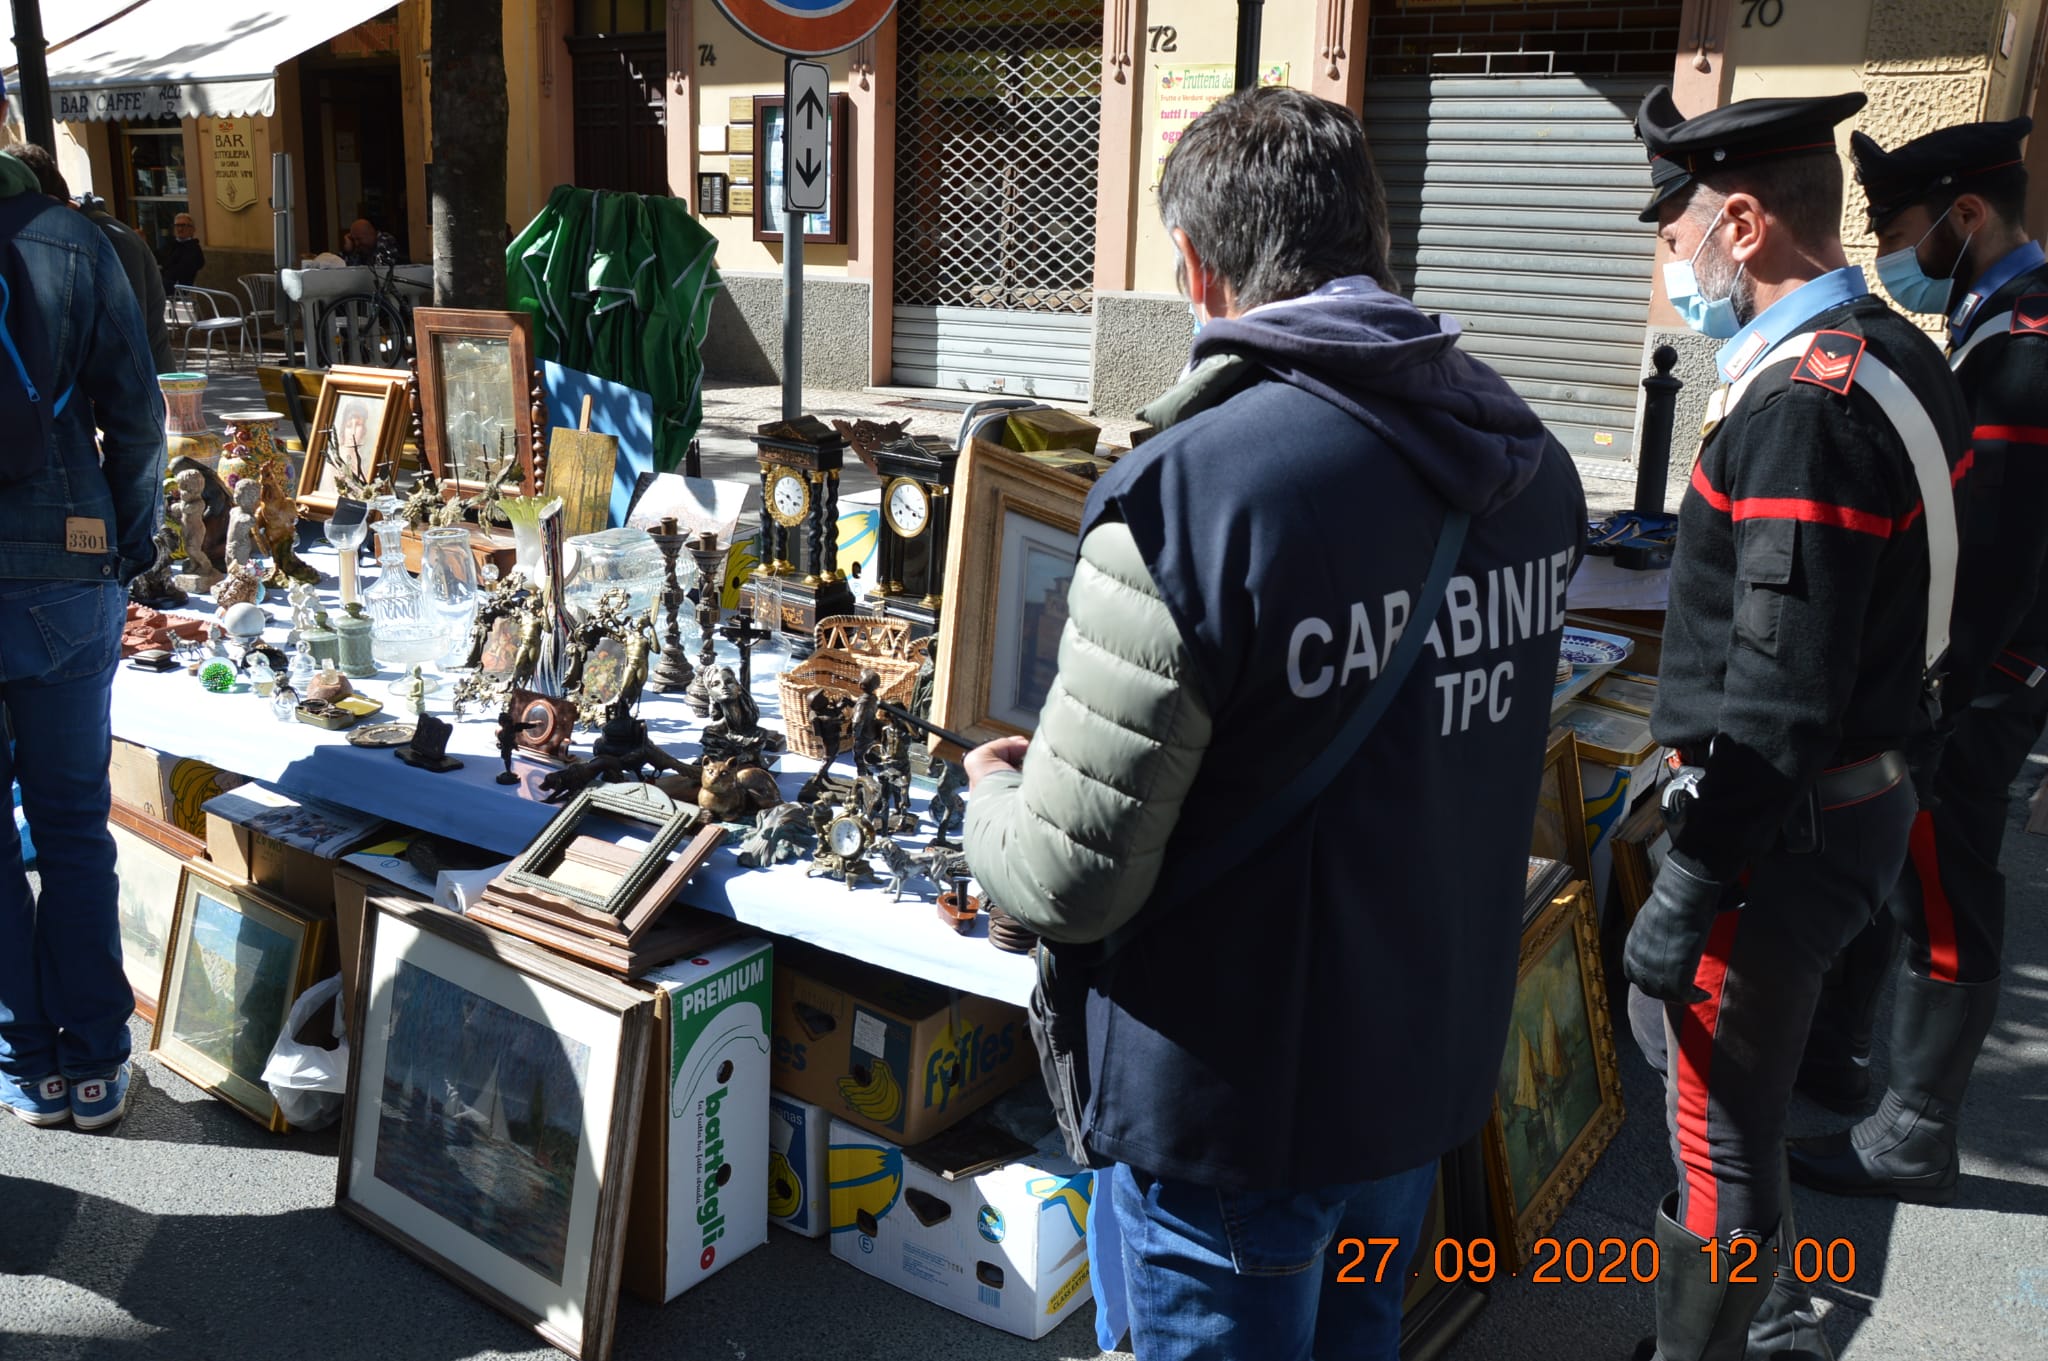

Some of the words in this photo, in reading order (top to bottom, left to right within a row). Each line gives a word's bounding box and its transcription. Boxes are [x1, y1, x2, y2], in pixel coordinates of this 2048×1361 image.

[1740, 0, 1784, 28] 70
[1148, 25, 1178, 53] 72
[698, 44, 717, 66] 74
[1182, 68, 1220, 89] Frutteria
[60, 95, 88, 114] BAR
[96, 91, 146, 112] CAFFE'
[1161, 109, 1181, 119] tutti
[215, 134, 244, 148] BAR
[69, 533, 105, 549] 3301
[1435, 660, 1514, 736] TPC
[682, 958, 764, 1021] PREMIUM
[697, 1086, 728, 1270] battaglio
